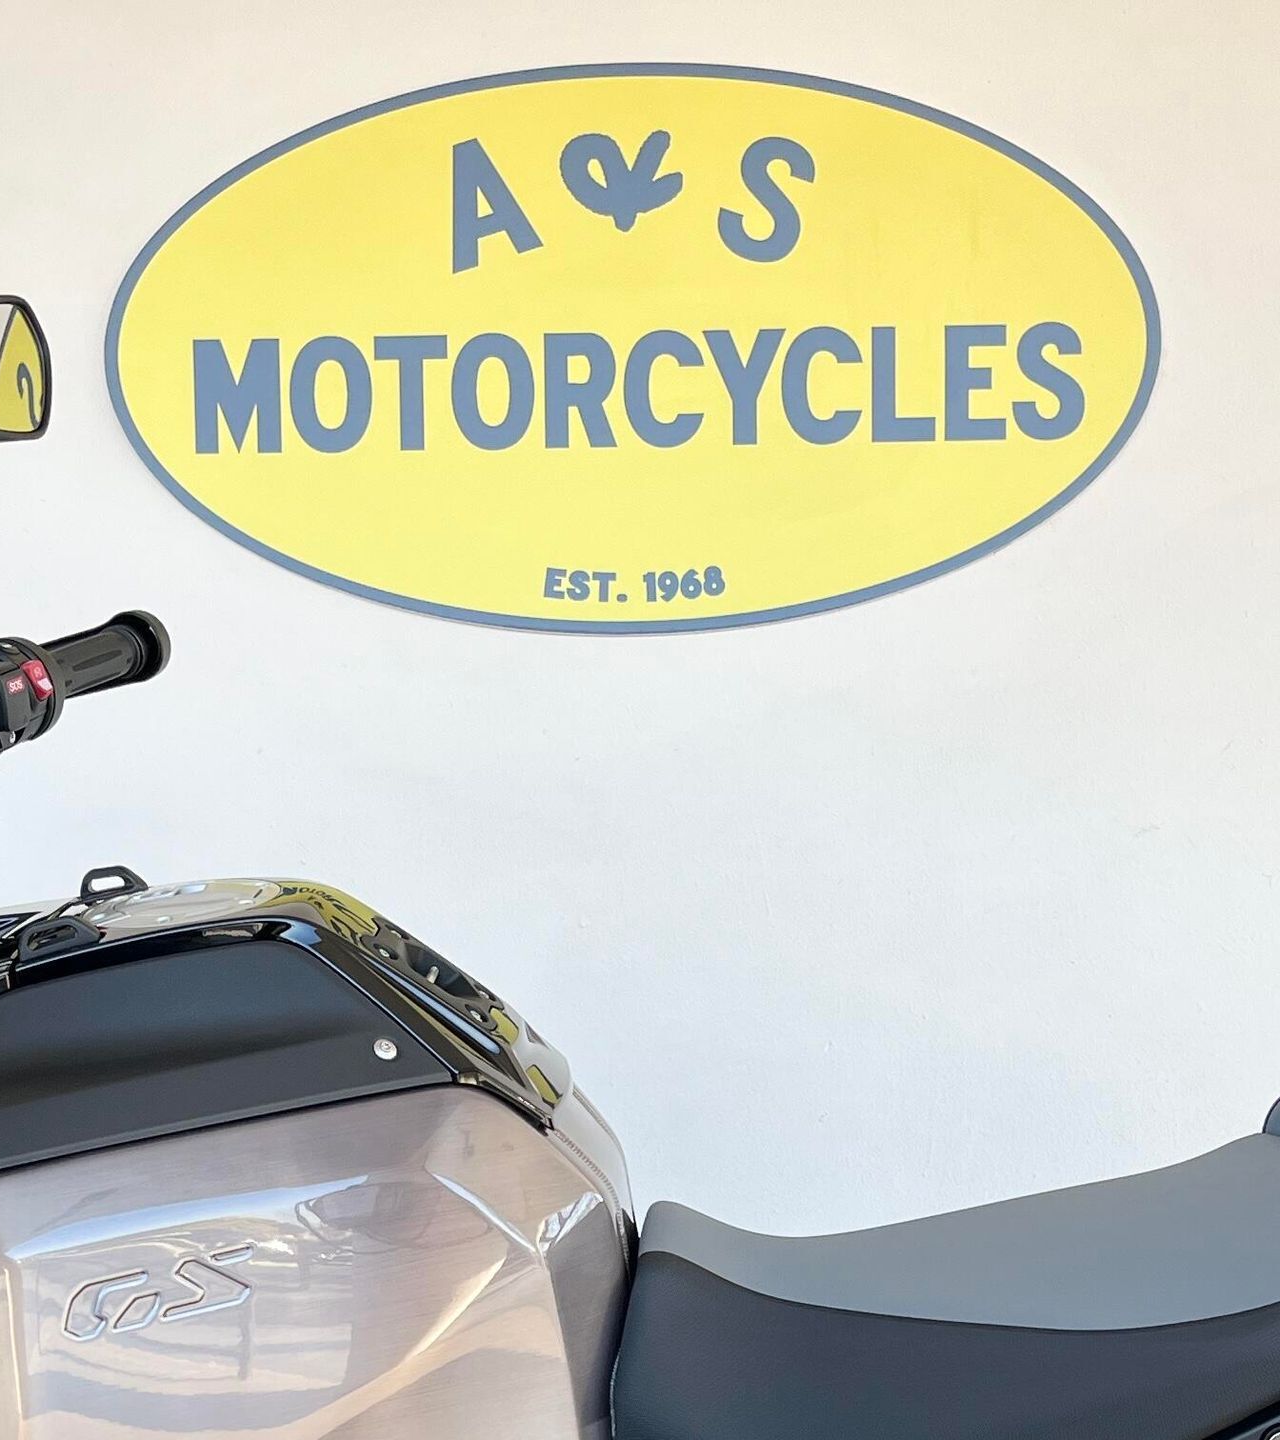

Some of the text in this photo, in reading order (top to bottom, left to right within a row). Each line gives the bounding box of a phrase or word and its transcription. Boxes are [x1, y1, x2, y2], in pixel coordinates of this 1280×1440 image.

[452, 138, 543, 273] A
[717, 136, 816, 263] S
[191, 321, 1085, 455] MOTORCYCLES
[543, 565, 726, 603] EST. 1968
[62, 1241, 252, 1341] GS
